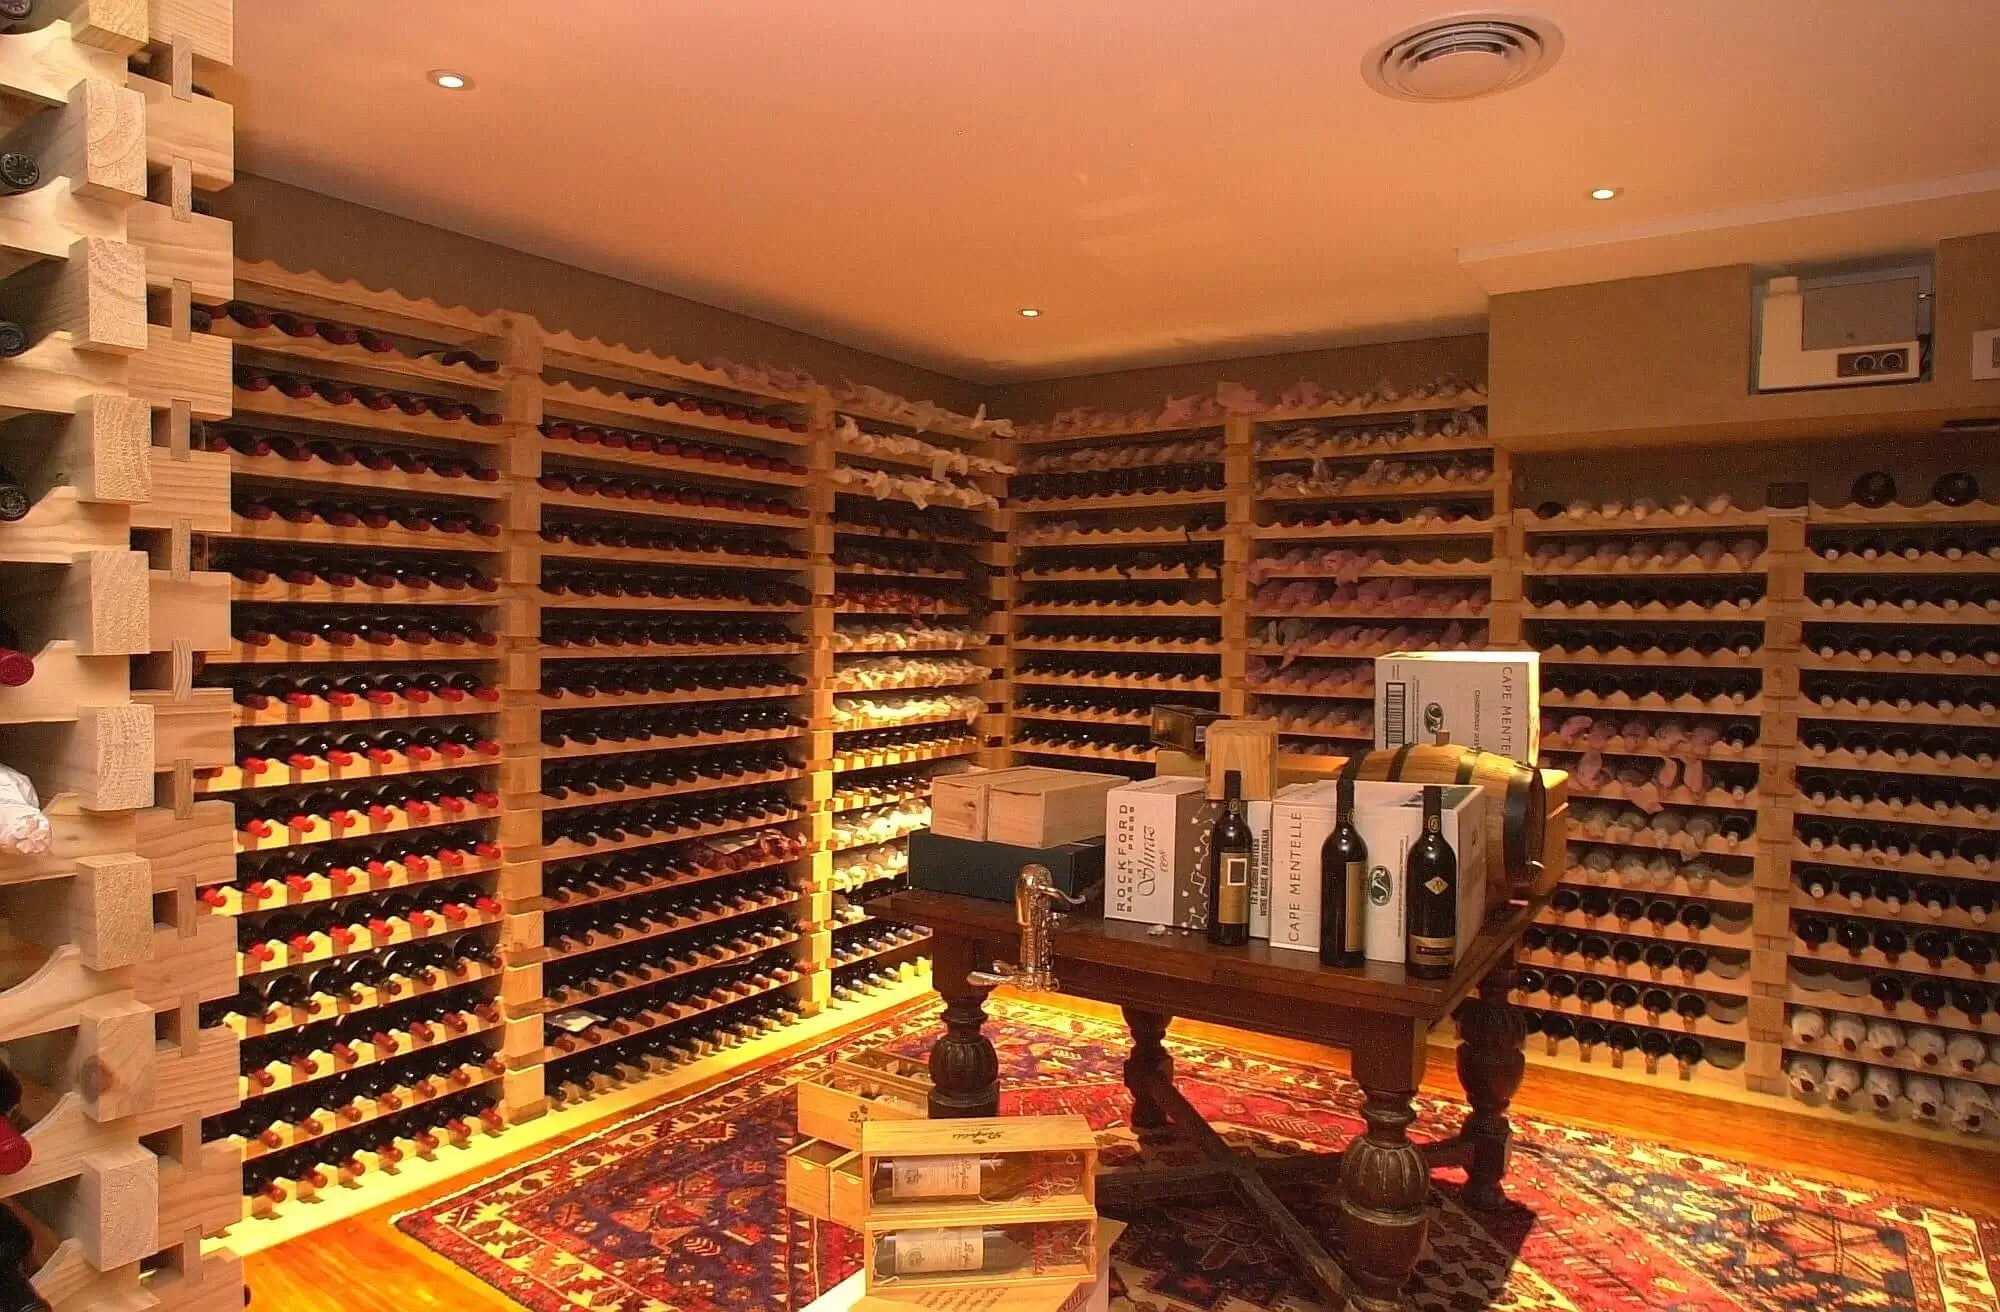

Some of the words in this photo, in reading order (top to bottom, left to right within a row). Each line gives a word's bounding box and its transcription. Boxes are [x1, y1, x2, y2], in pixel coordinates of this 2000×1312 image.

[1502, 666, 1512, 700] CAPE
[1500, 706, 1512, 757] MENTEL
[1117, 804, 1128, 912] ROCKFORD
[1137, 825, 1156, 897] Shiraz
[1261, 829, 1269, 866] AUSTRALIA
[1289, 812, 1302, 895] MENTELLE
[1126, 859, 1134, 912] BASKET
[1288, 903, 1301, 942] CAPE
